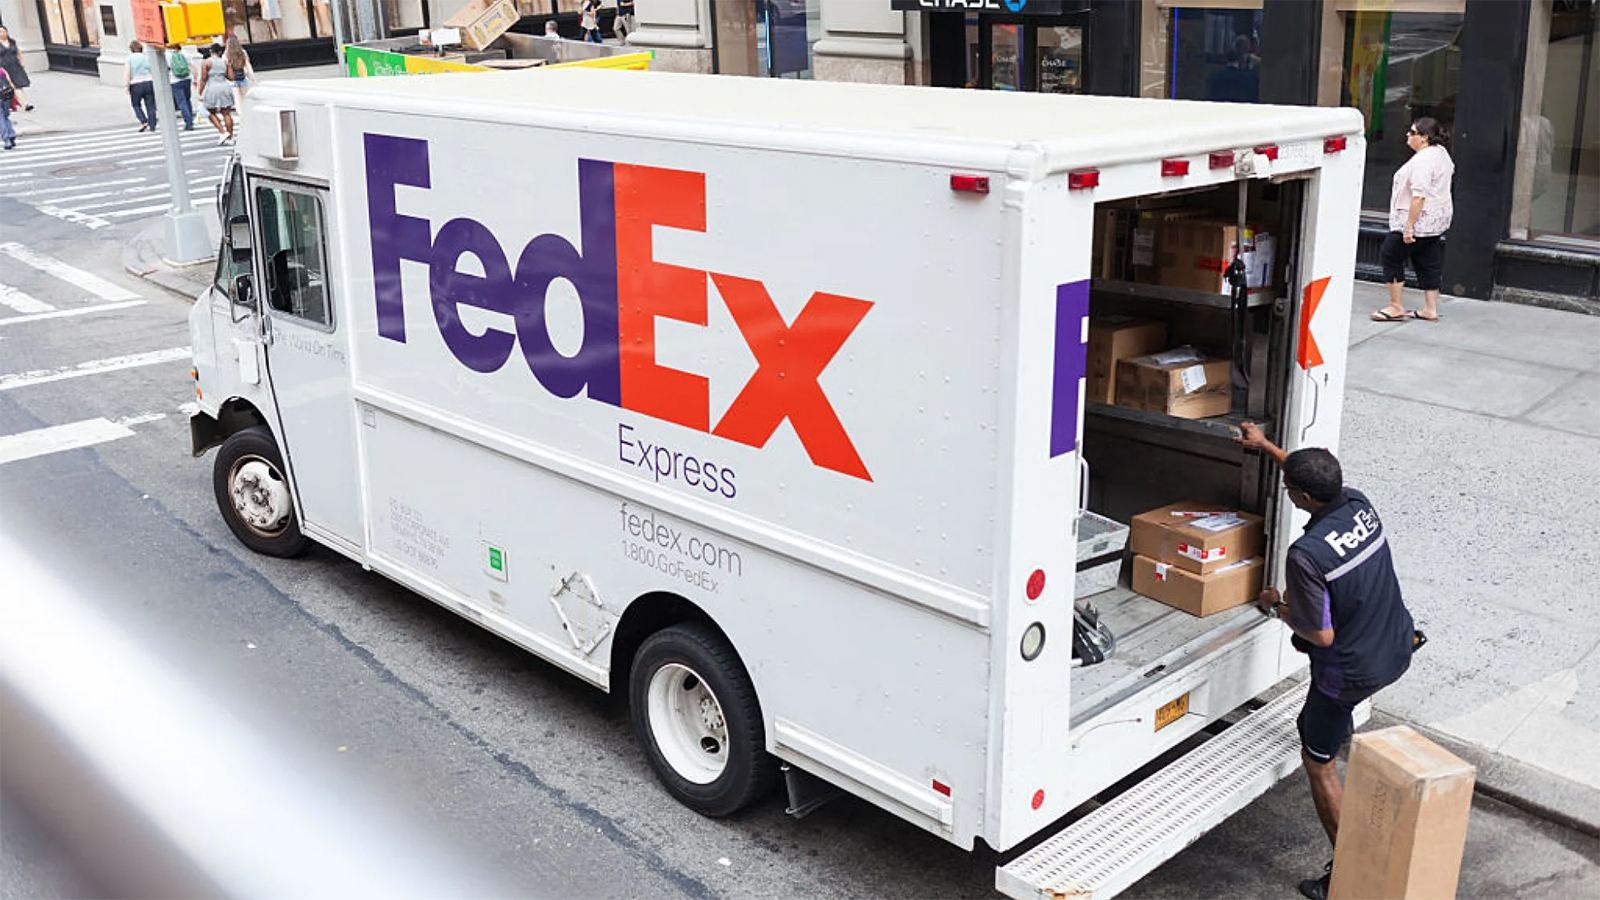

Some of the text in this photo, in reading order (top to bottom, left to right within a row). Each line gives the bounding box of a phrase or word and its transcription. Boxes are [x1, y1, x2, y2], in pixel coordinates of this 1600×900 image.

[363, 131, 876, 482] FedEx
[618, 422, 737, 499] Express
[620, 502, 742, 576] fedex.com
